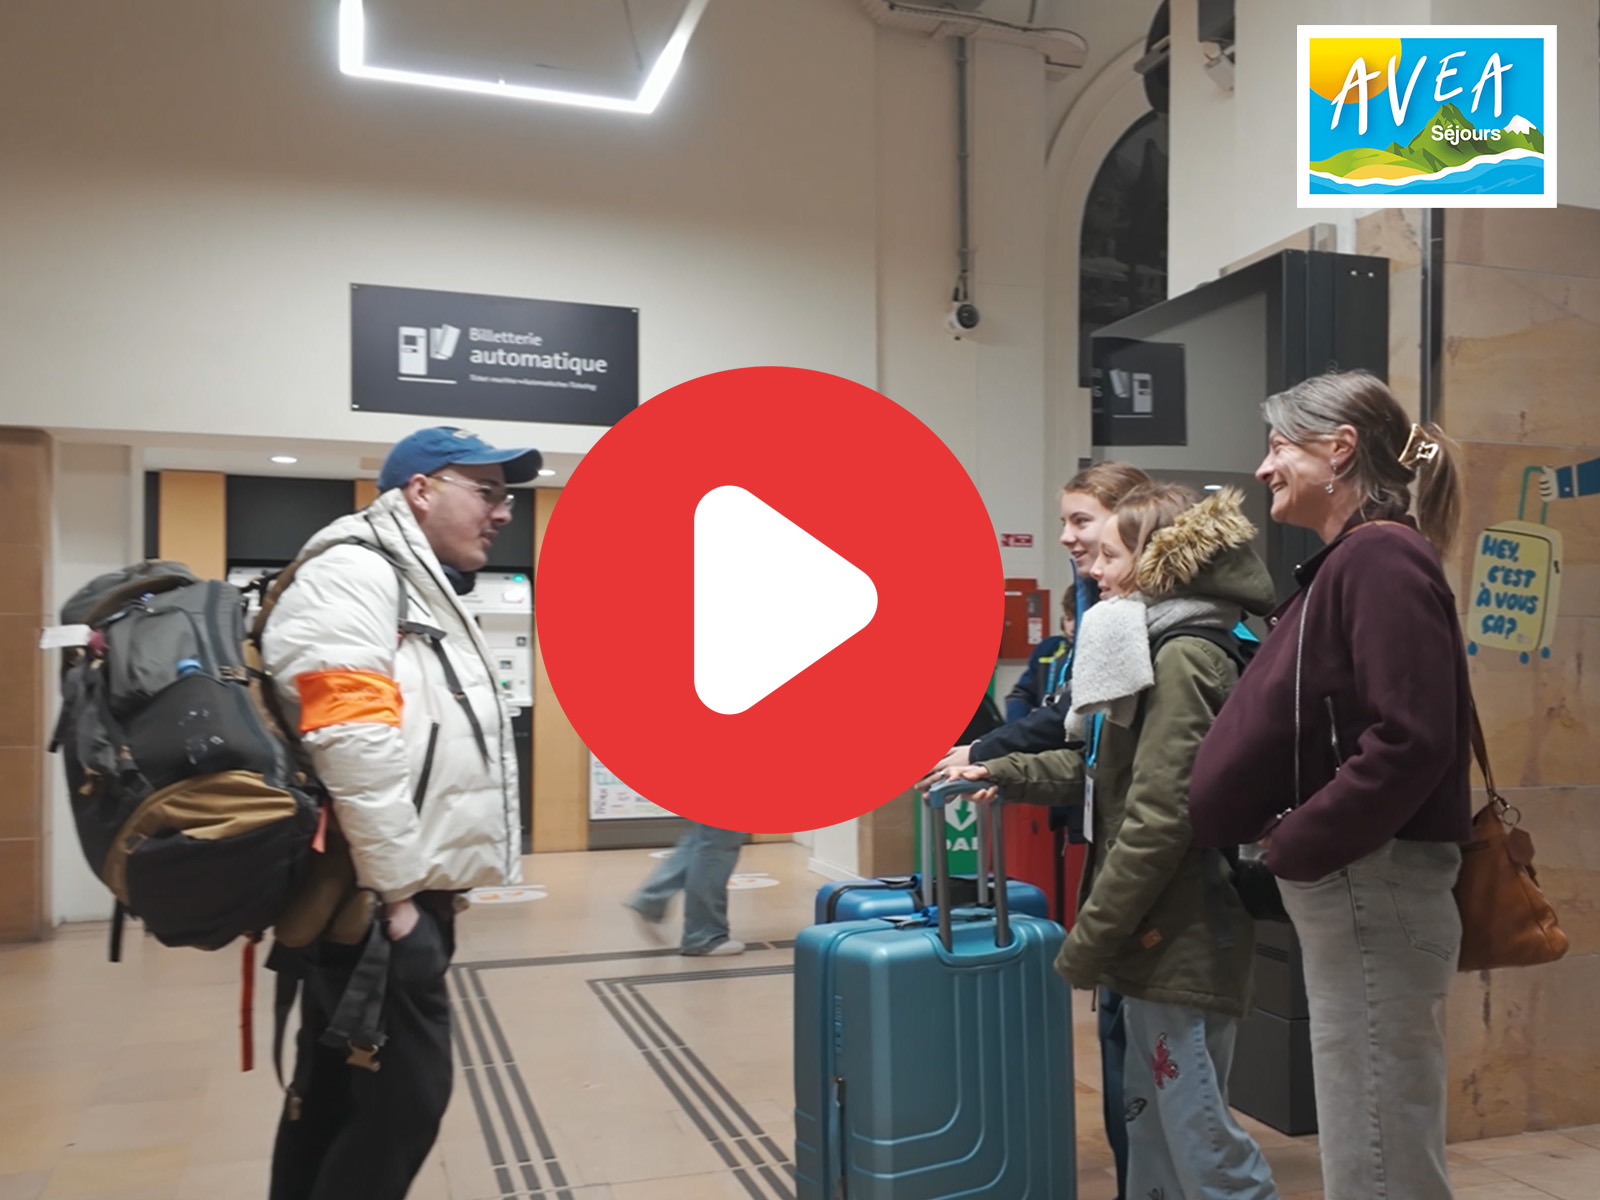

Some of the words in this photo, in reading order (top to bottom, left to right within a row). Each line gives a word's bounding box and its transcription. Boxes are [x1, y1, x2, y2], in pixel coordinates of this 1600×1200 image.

[469, 328, 543, 346] Billetterie
[470, 349, 608, 375] automatique
[1488, 565, 1536, 588] C'EST
[1495, 592, 1538, 614] VOUS
[1482, 614, 1517, 639] ÇA?
